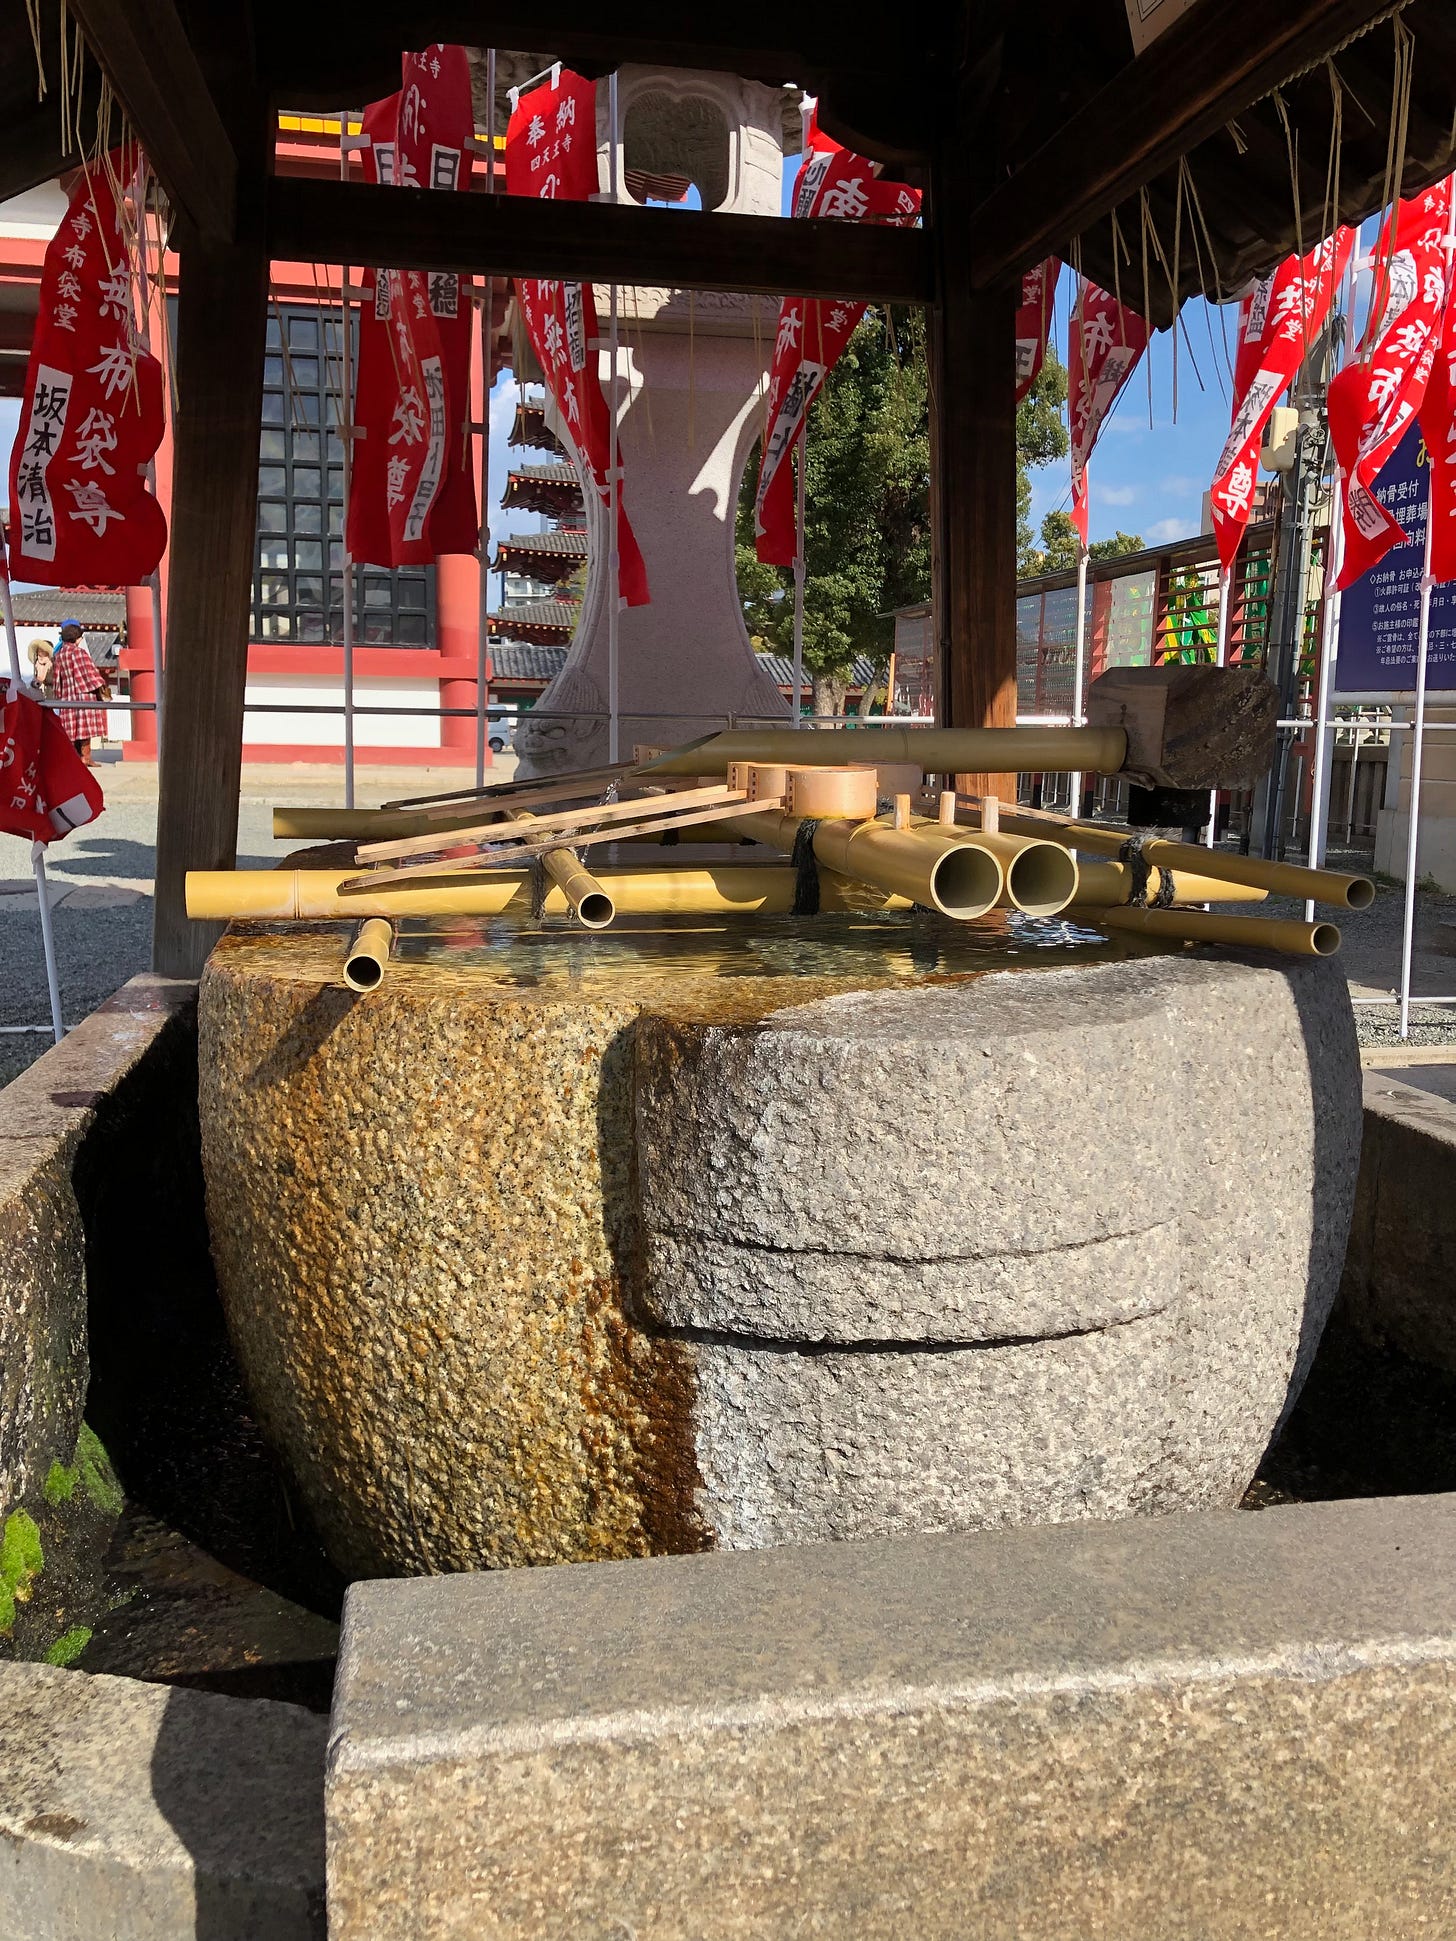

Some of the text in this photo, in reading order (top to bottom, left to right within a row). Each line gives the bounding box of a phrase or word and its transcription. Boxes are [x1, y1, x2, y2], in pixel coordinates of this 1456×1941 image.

[526, 96, 576, 149] 奉納
[531, 133, 573, 172] 四天王寺
[62, 257, 150, 538] 無布袋尊
[18, 383, 69, 546] 坂本清治
